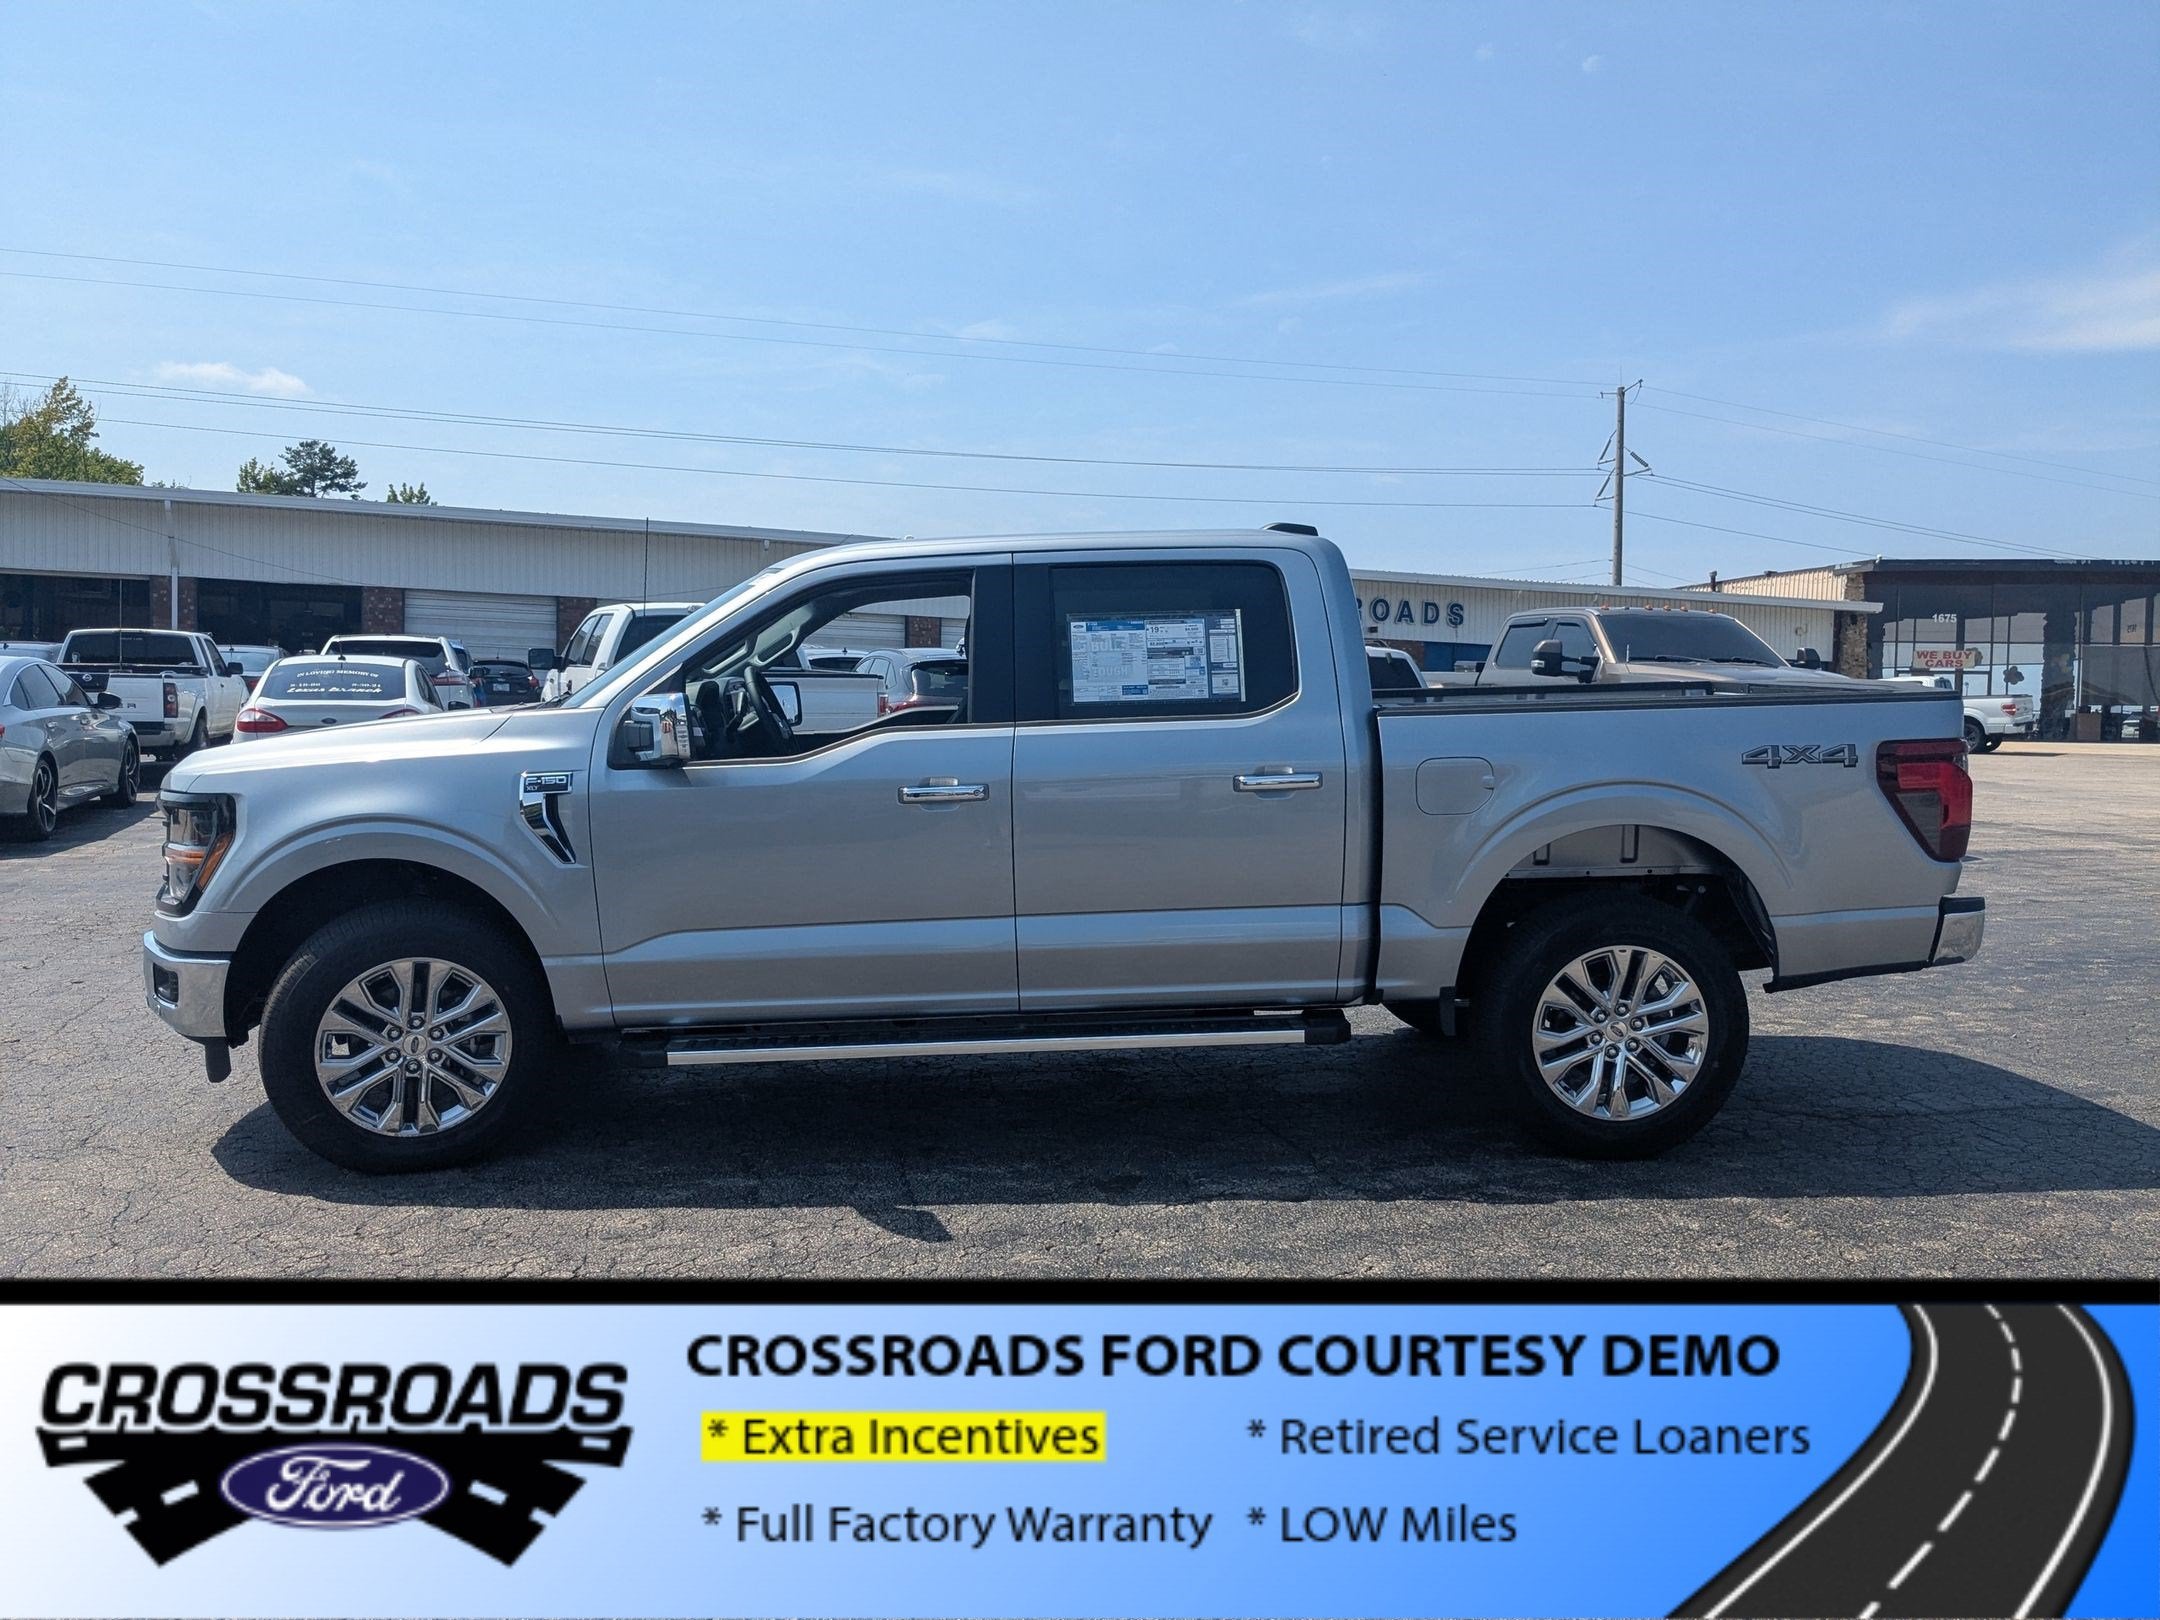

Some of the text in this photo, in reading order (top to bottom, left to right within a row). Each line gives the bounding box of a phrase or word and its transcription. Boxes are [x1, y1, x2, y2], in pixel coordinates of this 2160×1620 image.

[1931, 613, 1957, 623] 1675
[1916, 650, 1973, 660] WE BUY
[1924, 659, 1964, 668] CARS
[336, 669, 369, 677] MEMORY
[525, 776, 567, 785] F-150
